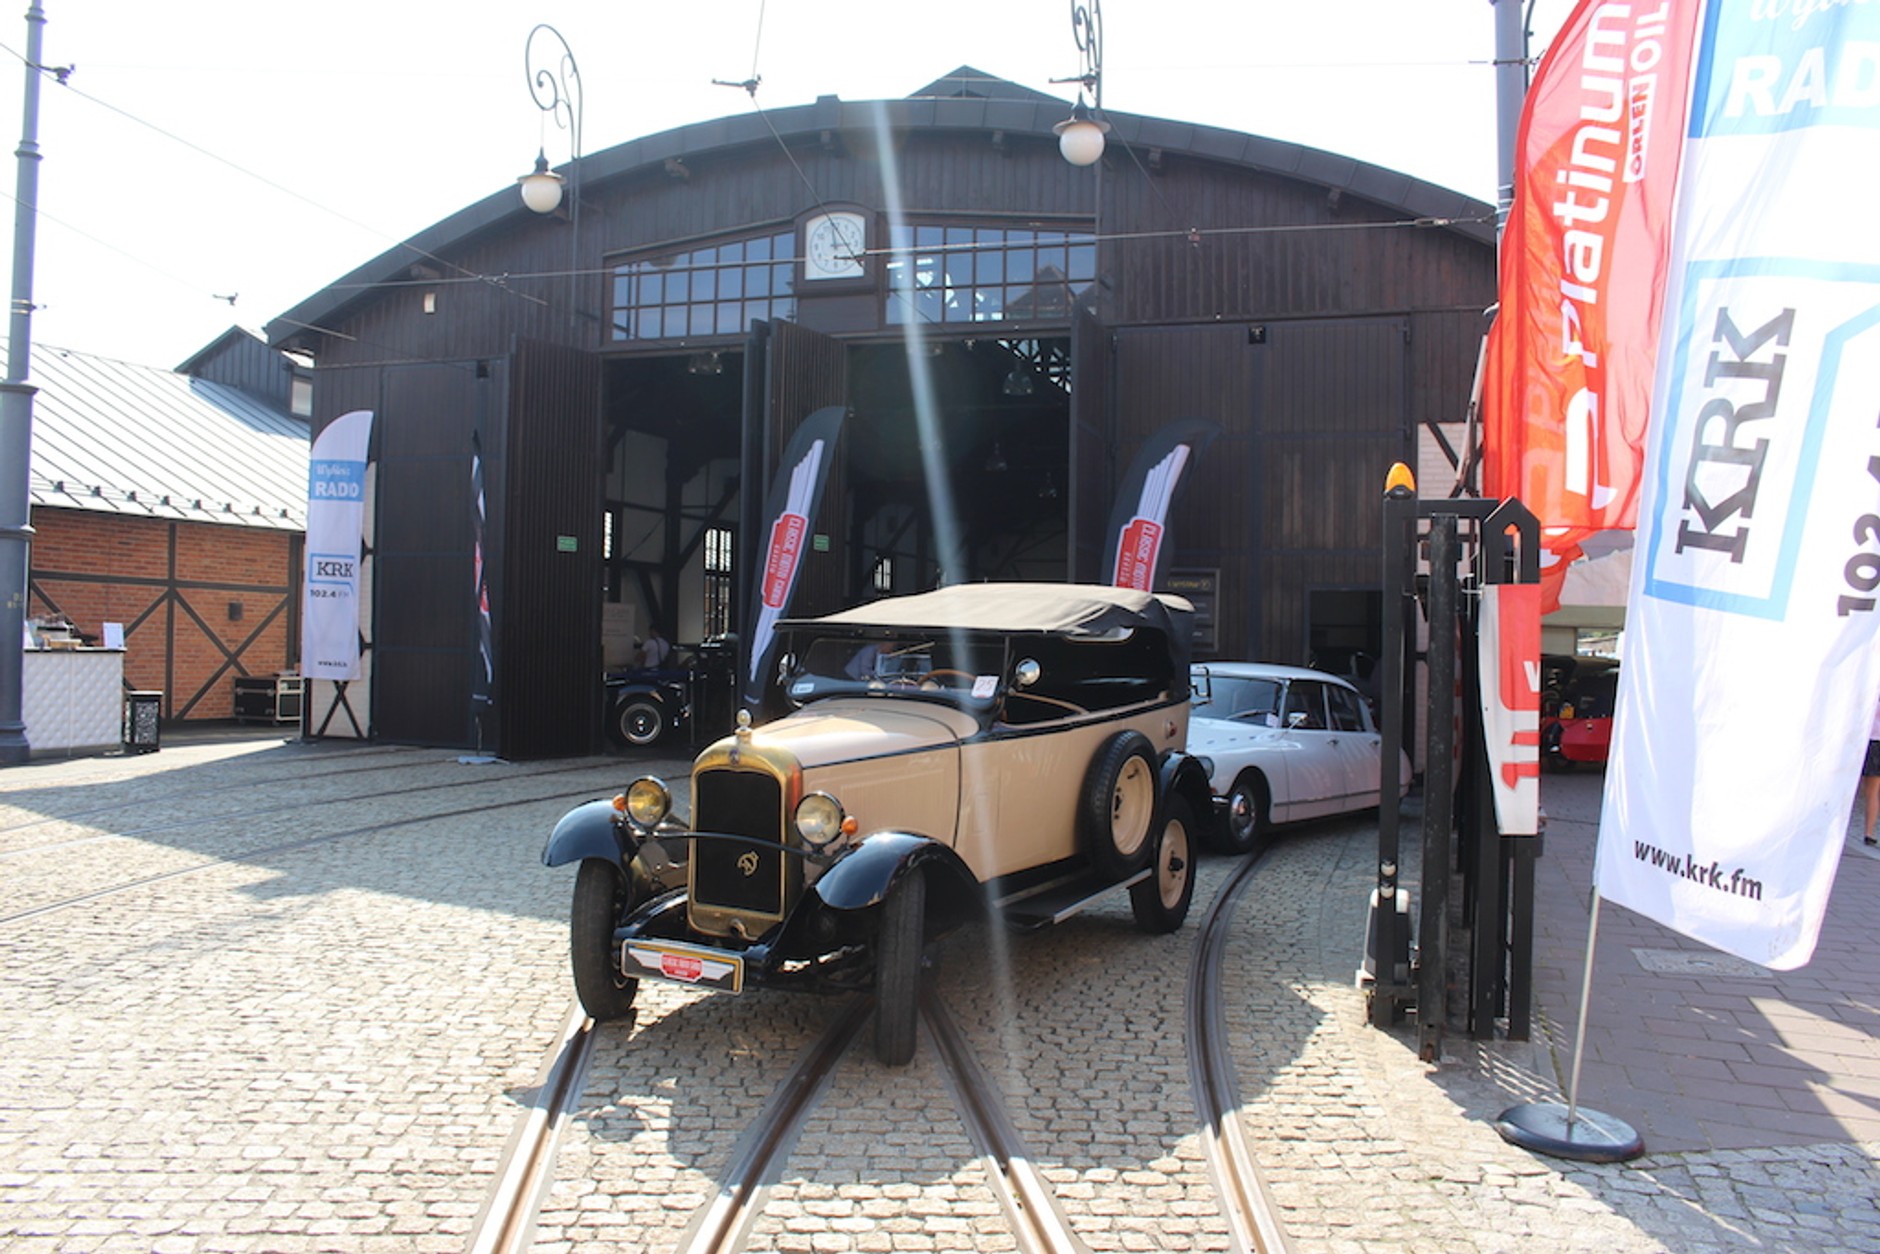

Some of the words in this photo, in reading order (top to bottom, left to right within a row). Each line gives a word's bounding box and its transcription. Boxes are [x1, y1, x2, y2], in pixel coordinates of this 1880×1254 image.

[1630, 2, 1670, 72] OIL
[1630, 81, 1651, 176] ORLEN
[1553, 3, 1631, 368] Platinum
[1675, 307, 1796, 563] KRK
[316, 562, 353, 577] KRK
[1634, 840, 1762, 901] www.krk.fm
